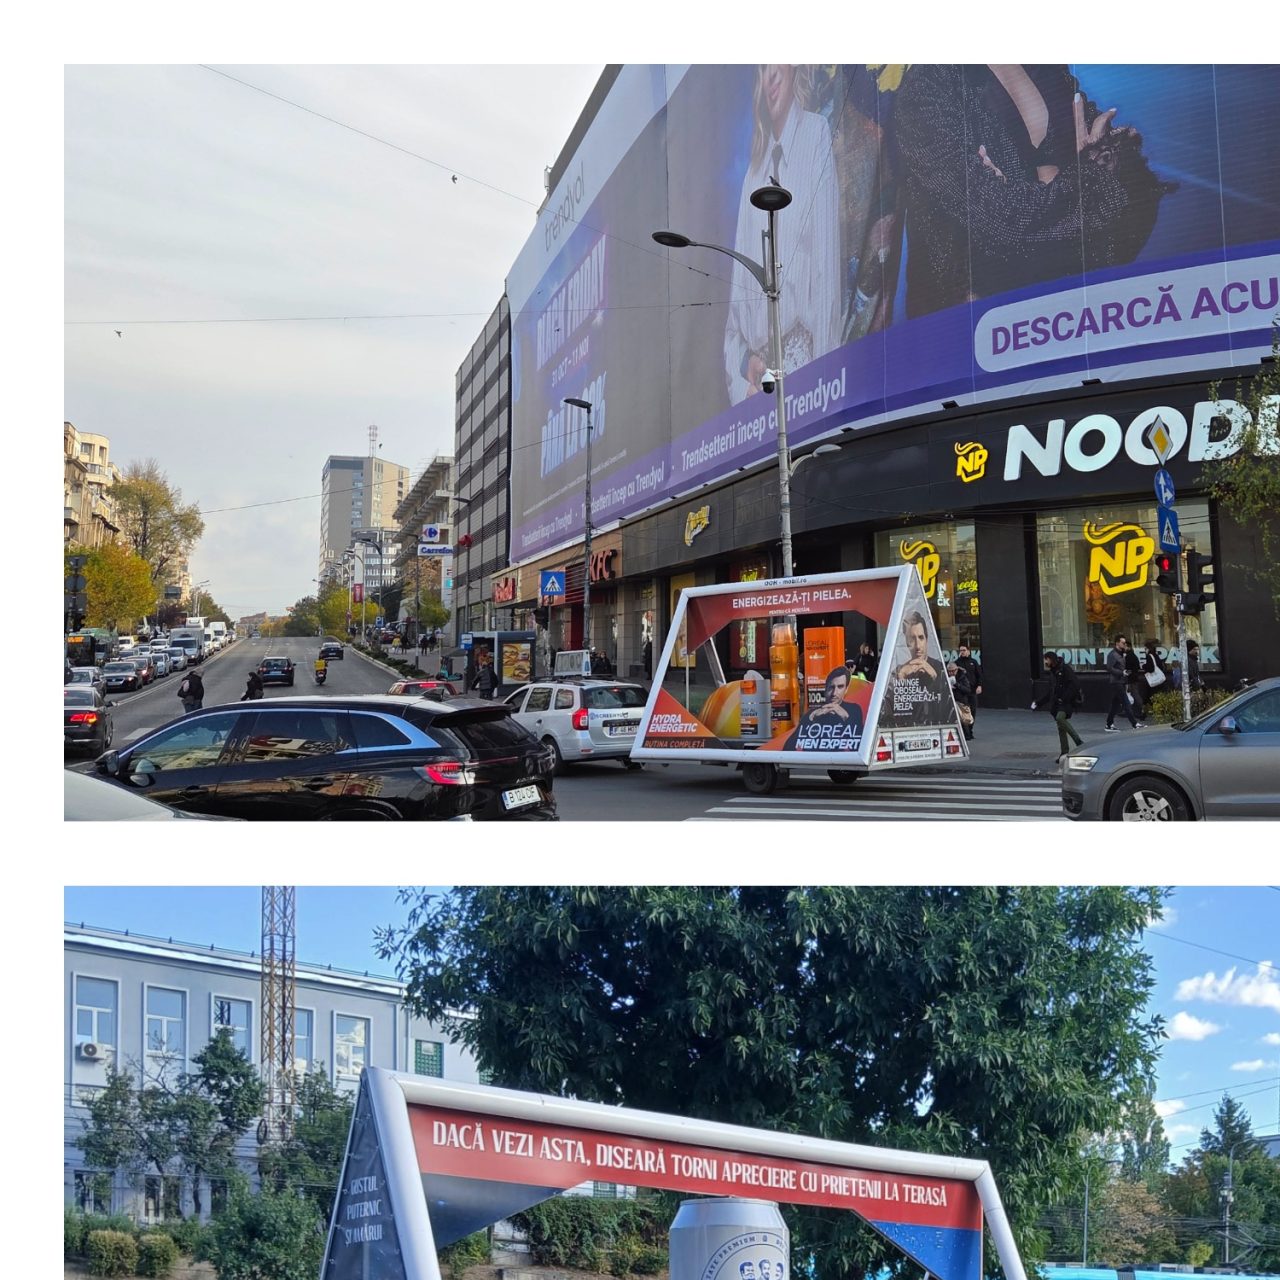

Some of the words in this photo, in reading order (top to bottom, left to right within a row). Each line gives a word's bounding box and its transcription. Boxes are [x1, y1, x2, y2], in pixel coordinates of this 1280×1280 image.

[545, 161, 585, 251] trendyol
[537, 286, 566, 372] BLACK
[566, 234, 606, 337] FRIDAY
[991, 282, 1174, 356] DESCARCĂ
[681, 416, 736, 471] Trendsetterii
[737, 417, 766, 450] încep
[784, 367, 846, 422] Trendyol
[636, 461, 664, 493] Trendyol
[421, 546, 453, 555] Carrefou
[1089, 537, 1154, 582] NP
[589, 551, 613, 584] KFC
[733, 591, 810, 608] ENERGIZEAZĂ-ȚI
[813, 588, 851, 601] PIELEA.
[943, 650, 981, 665] PAK
[1044, 648, 1096, 665] OIN
[1099, 648, 1147, 668] TE
[1154, 648, 1220, 665] PAK
[893, 678, 919, 686] ÎNVINGE
[893, 702, 913, 710] PIELEA
[649, 723, 698, 733] ENERGETIC
[652, 714, 681, 724] HYDRA
[799, 723, 862, 738] L'ORÉAL
[645, 740, 670, 748] RUTINA
[672, 738, 705, 748] COMPLETĂ
[796, 739, 819, 749] MEN
[819, 738, 861, 749] EXPERT
[433, 1120, 484, 1151] DACĂ
[491, 1129, 533, 1157] VEZI
[539, 1136, 591, 1167] ASTA,
[596, 1143, 666, 1174] DISEARĂ
[671, 1154, 717, 1180] TORNI
[721, 1160, 797, 1190] APRECIERE
[800, 1171, 817, 1192] CU
[821, 1174, 881, 1199] PRIETENII
[885, 1181, 899, 1201] LA
[902, 1183, 947, 1207] TERASĂ
[350, 1175, 378, 1195] GUSTUL
[347, 1199, 382, 1220] PUTERNIC
